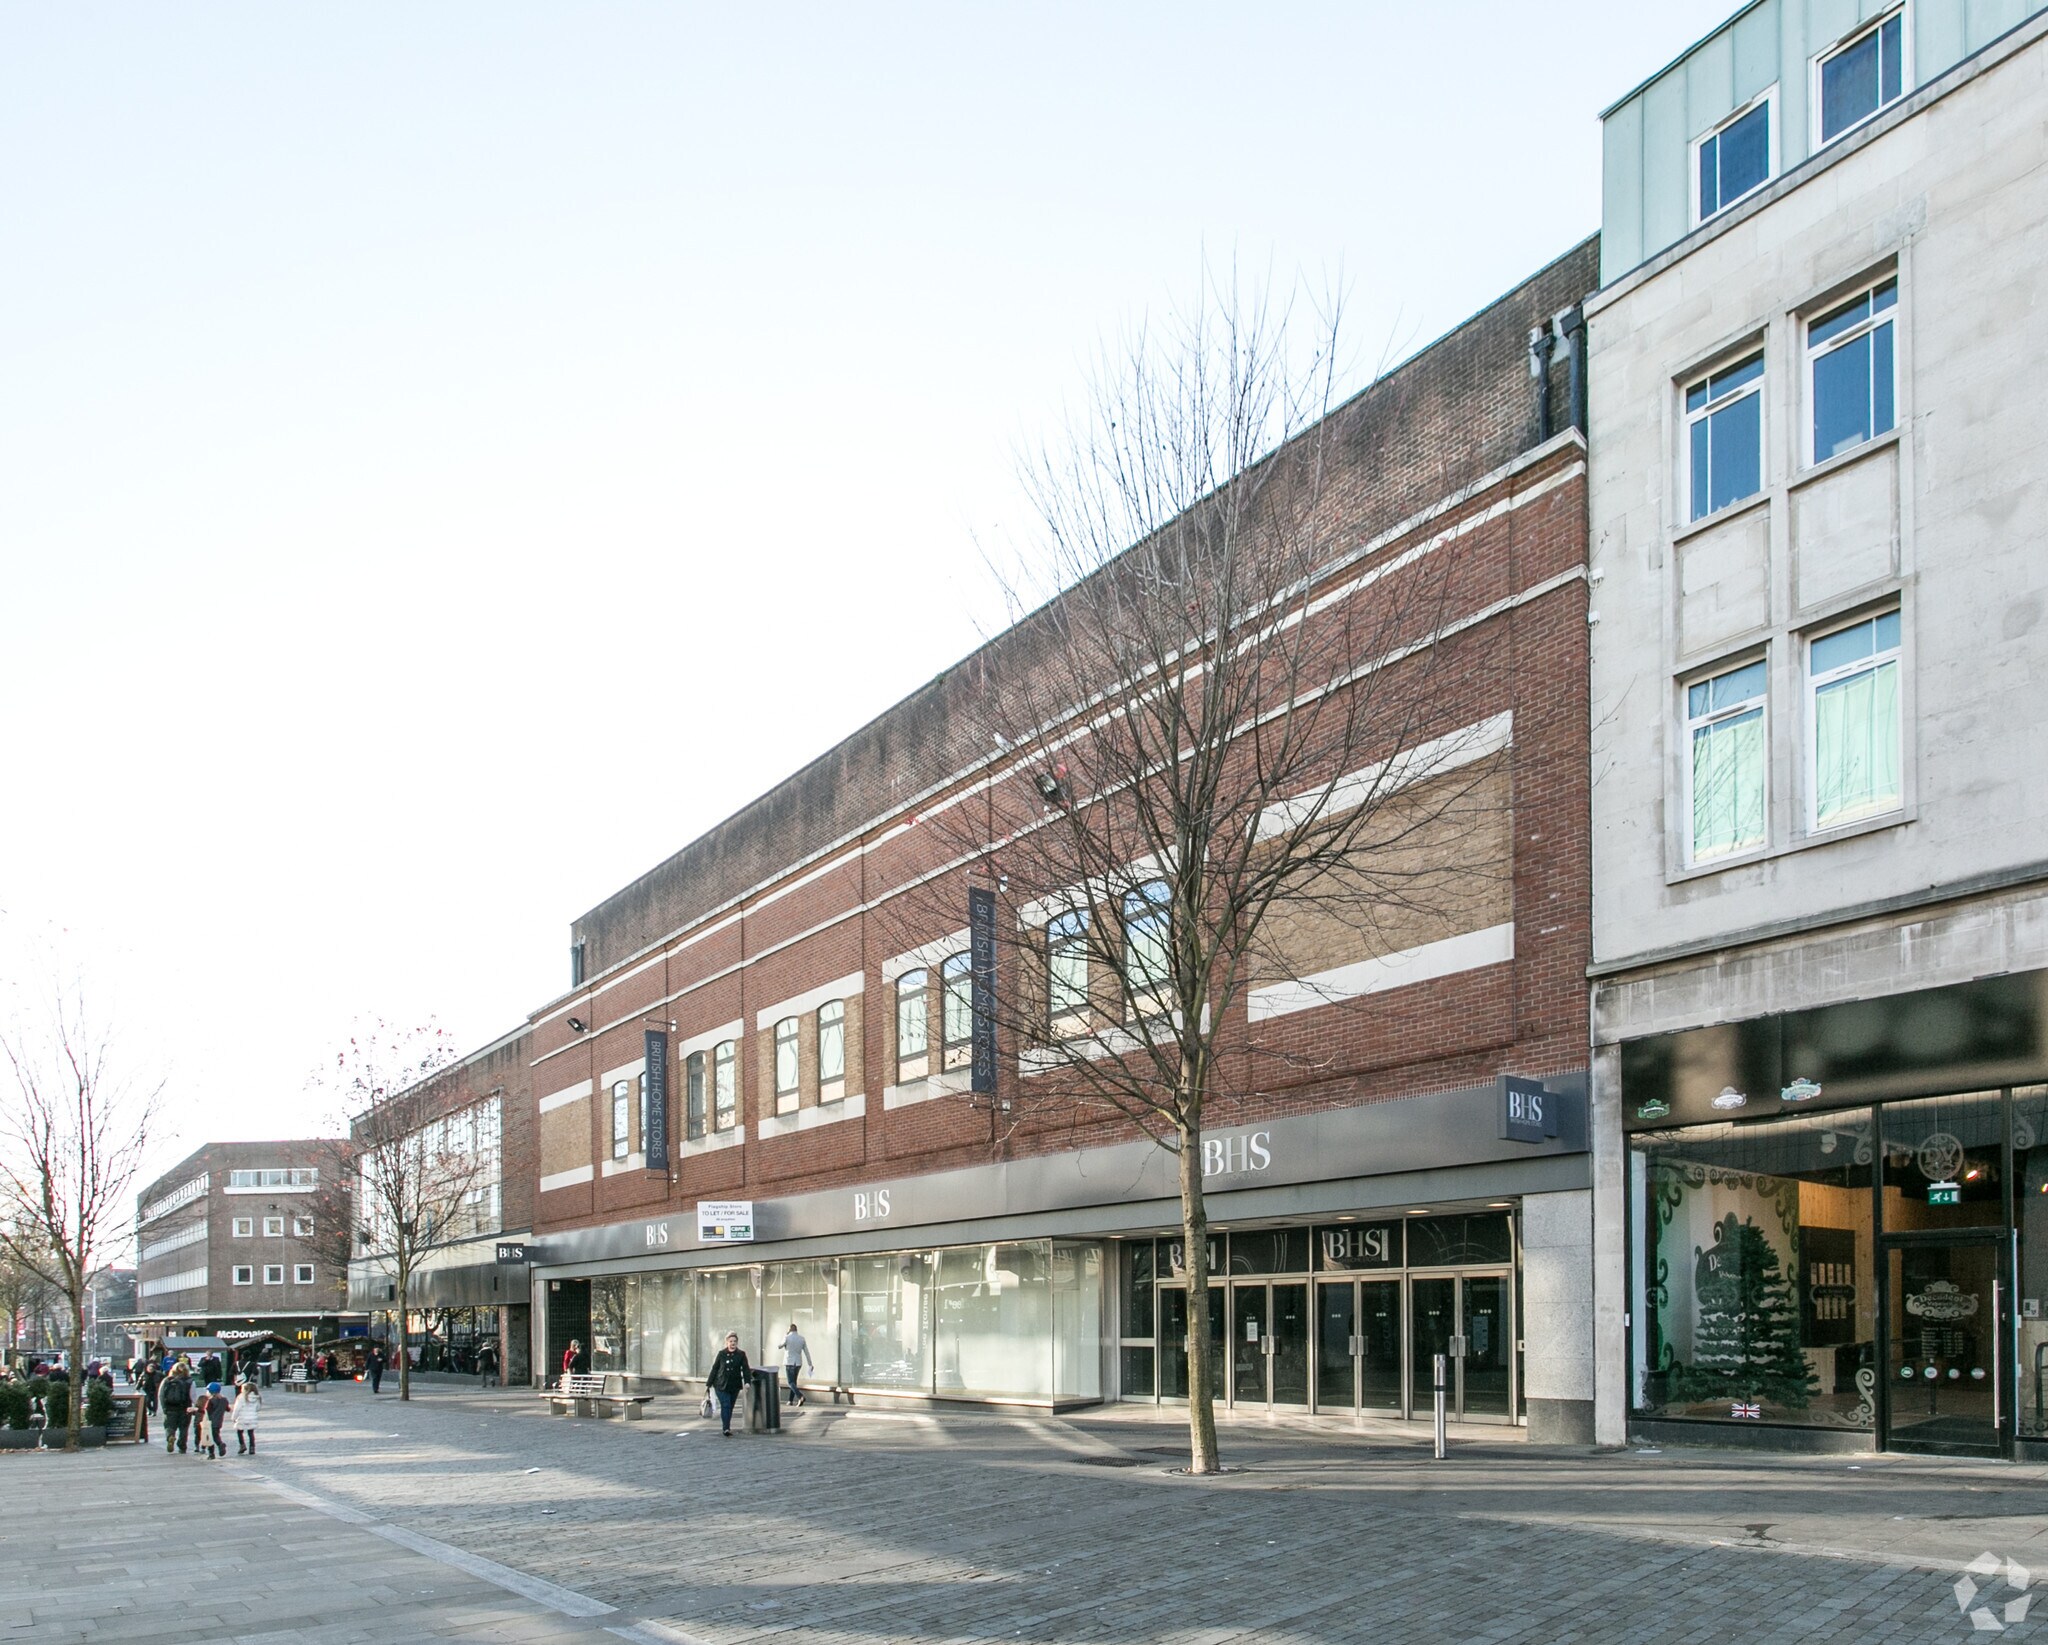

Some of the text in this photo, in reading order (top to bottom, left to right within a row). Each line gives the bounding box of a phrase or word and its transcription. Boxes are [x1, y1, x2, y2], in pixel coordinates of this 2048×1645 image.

[651, 1041, 662, 1159] BRITISH HOME STORES
[1509, 1091, 1542, 1121] BHS
[1202, 1131, 1271, 1177] BHS
[854, 1189, 891, 1221] BHS
[646, 1222, 668, 1245] BHS
[1329, 1228, 1381, 1258] BHS
[498, 1247, 523, 1258] BHS
